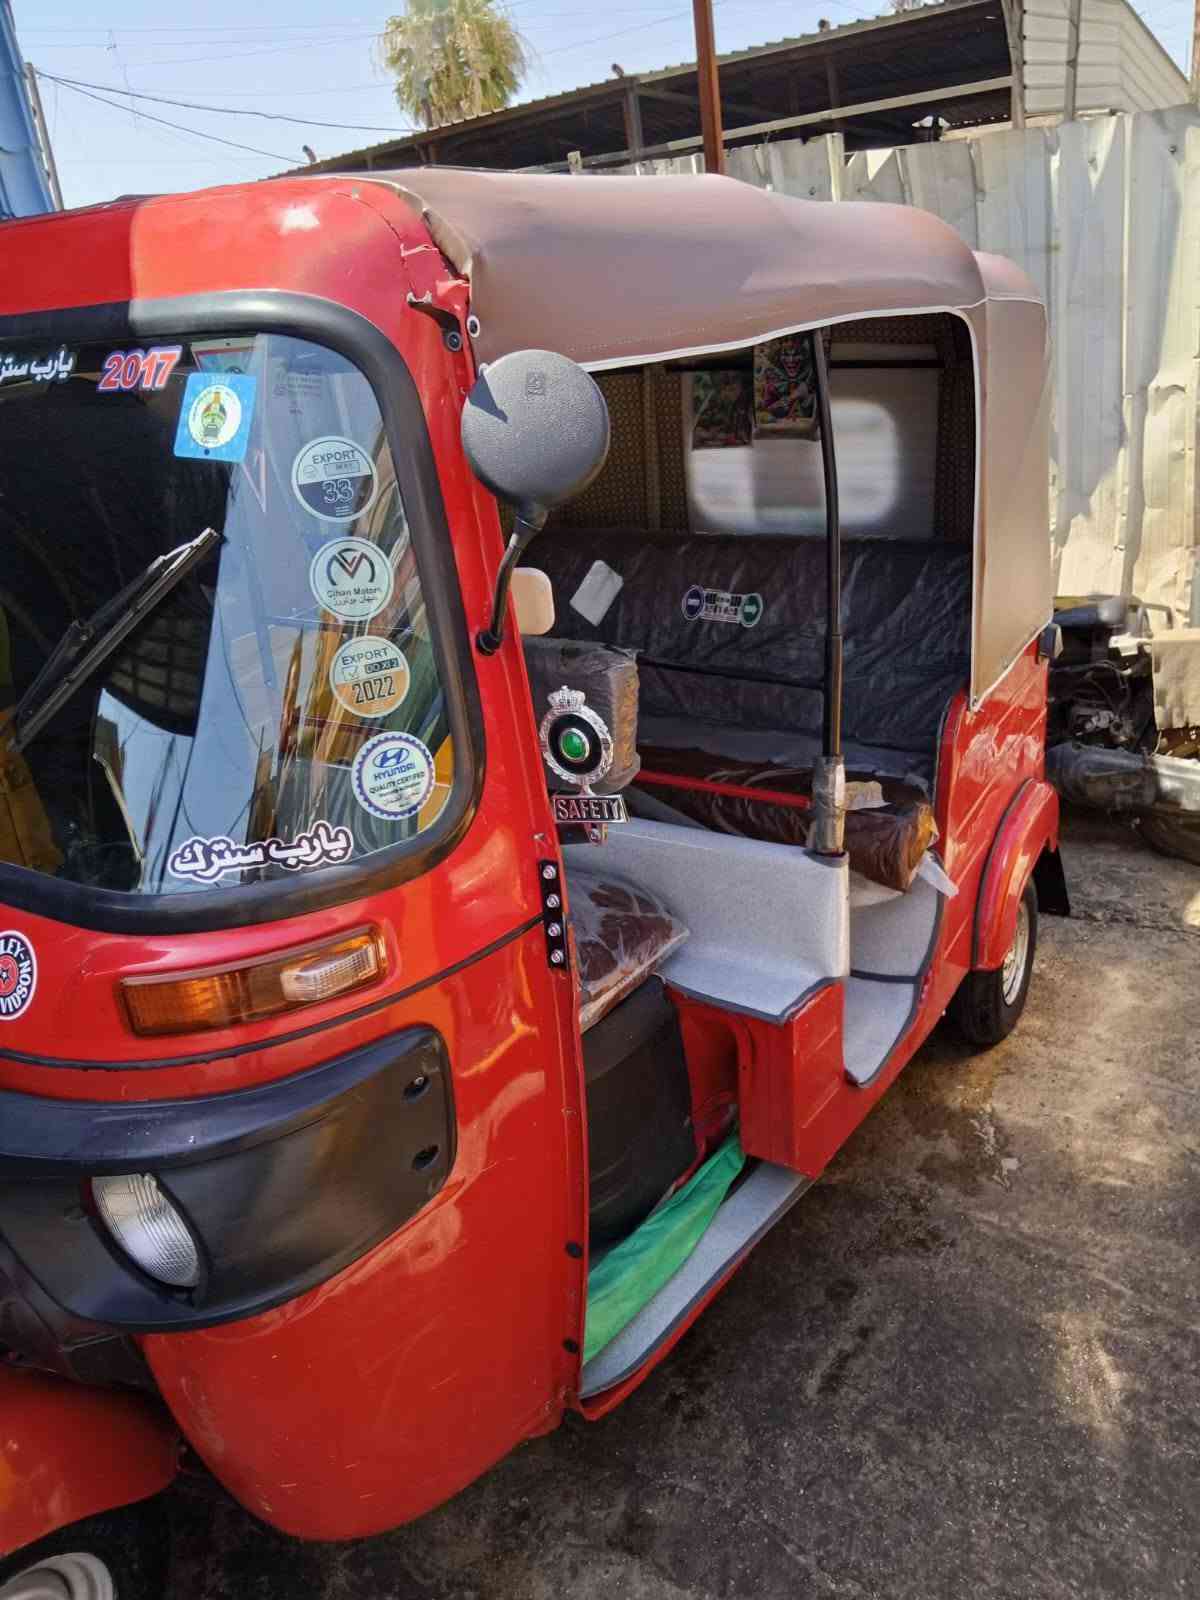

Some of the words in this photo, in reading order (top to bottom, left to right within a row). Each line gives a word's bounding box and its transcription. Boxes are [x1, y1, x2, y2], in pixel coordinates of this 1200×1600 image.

[0, 356, 29, 382] ستر
[97, 346, 183, 391] 2017
[311, 448, 357, 465] EXPORT
[341, 647, 388, 666] EXPORT
[352, 675, 396, 704] 2022
[373, 762, 416, 781] HYUNDAI
[555, 798, 622, 821] SAFETY
